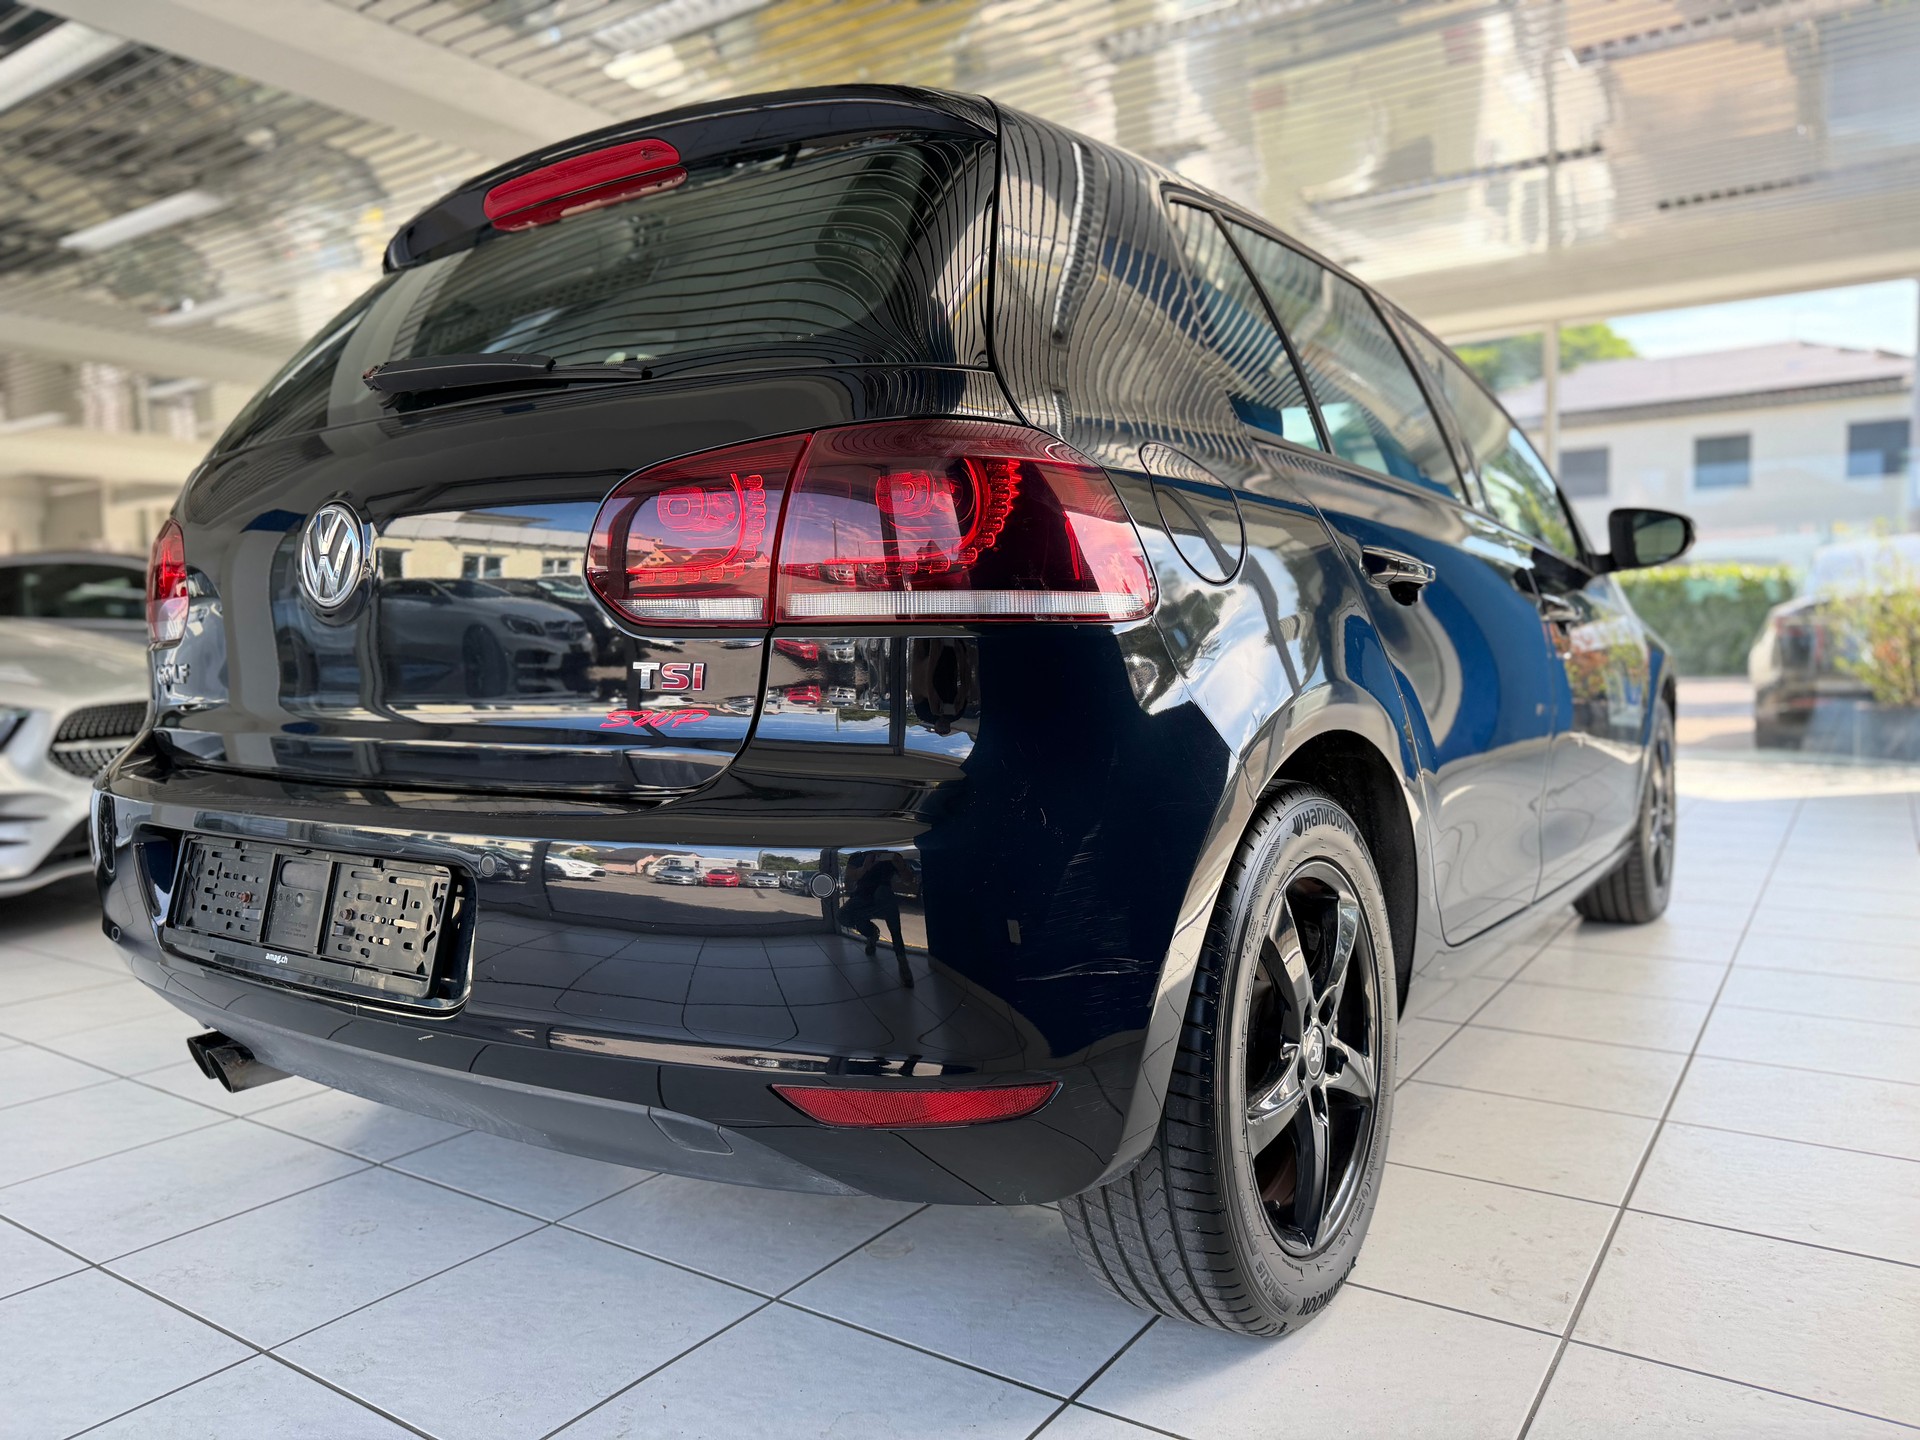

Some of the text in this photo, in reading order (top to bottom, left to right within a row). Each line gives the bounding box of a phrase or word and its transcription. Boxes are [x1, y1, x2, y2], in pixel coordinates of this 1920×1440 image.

[156, 664, 190, 684] GOLF
[632, 662, 705, 690] TSI
[265, 952, 289, 964] amag.ch
